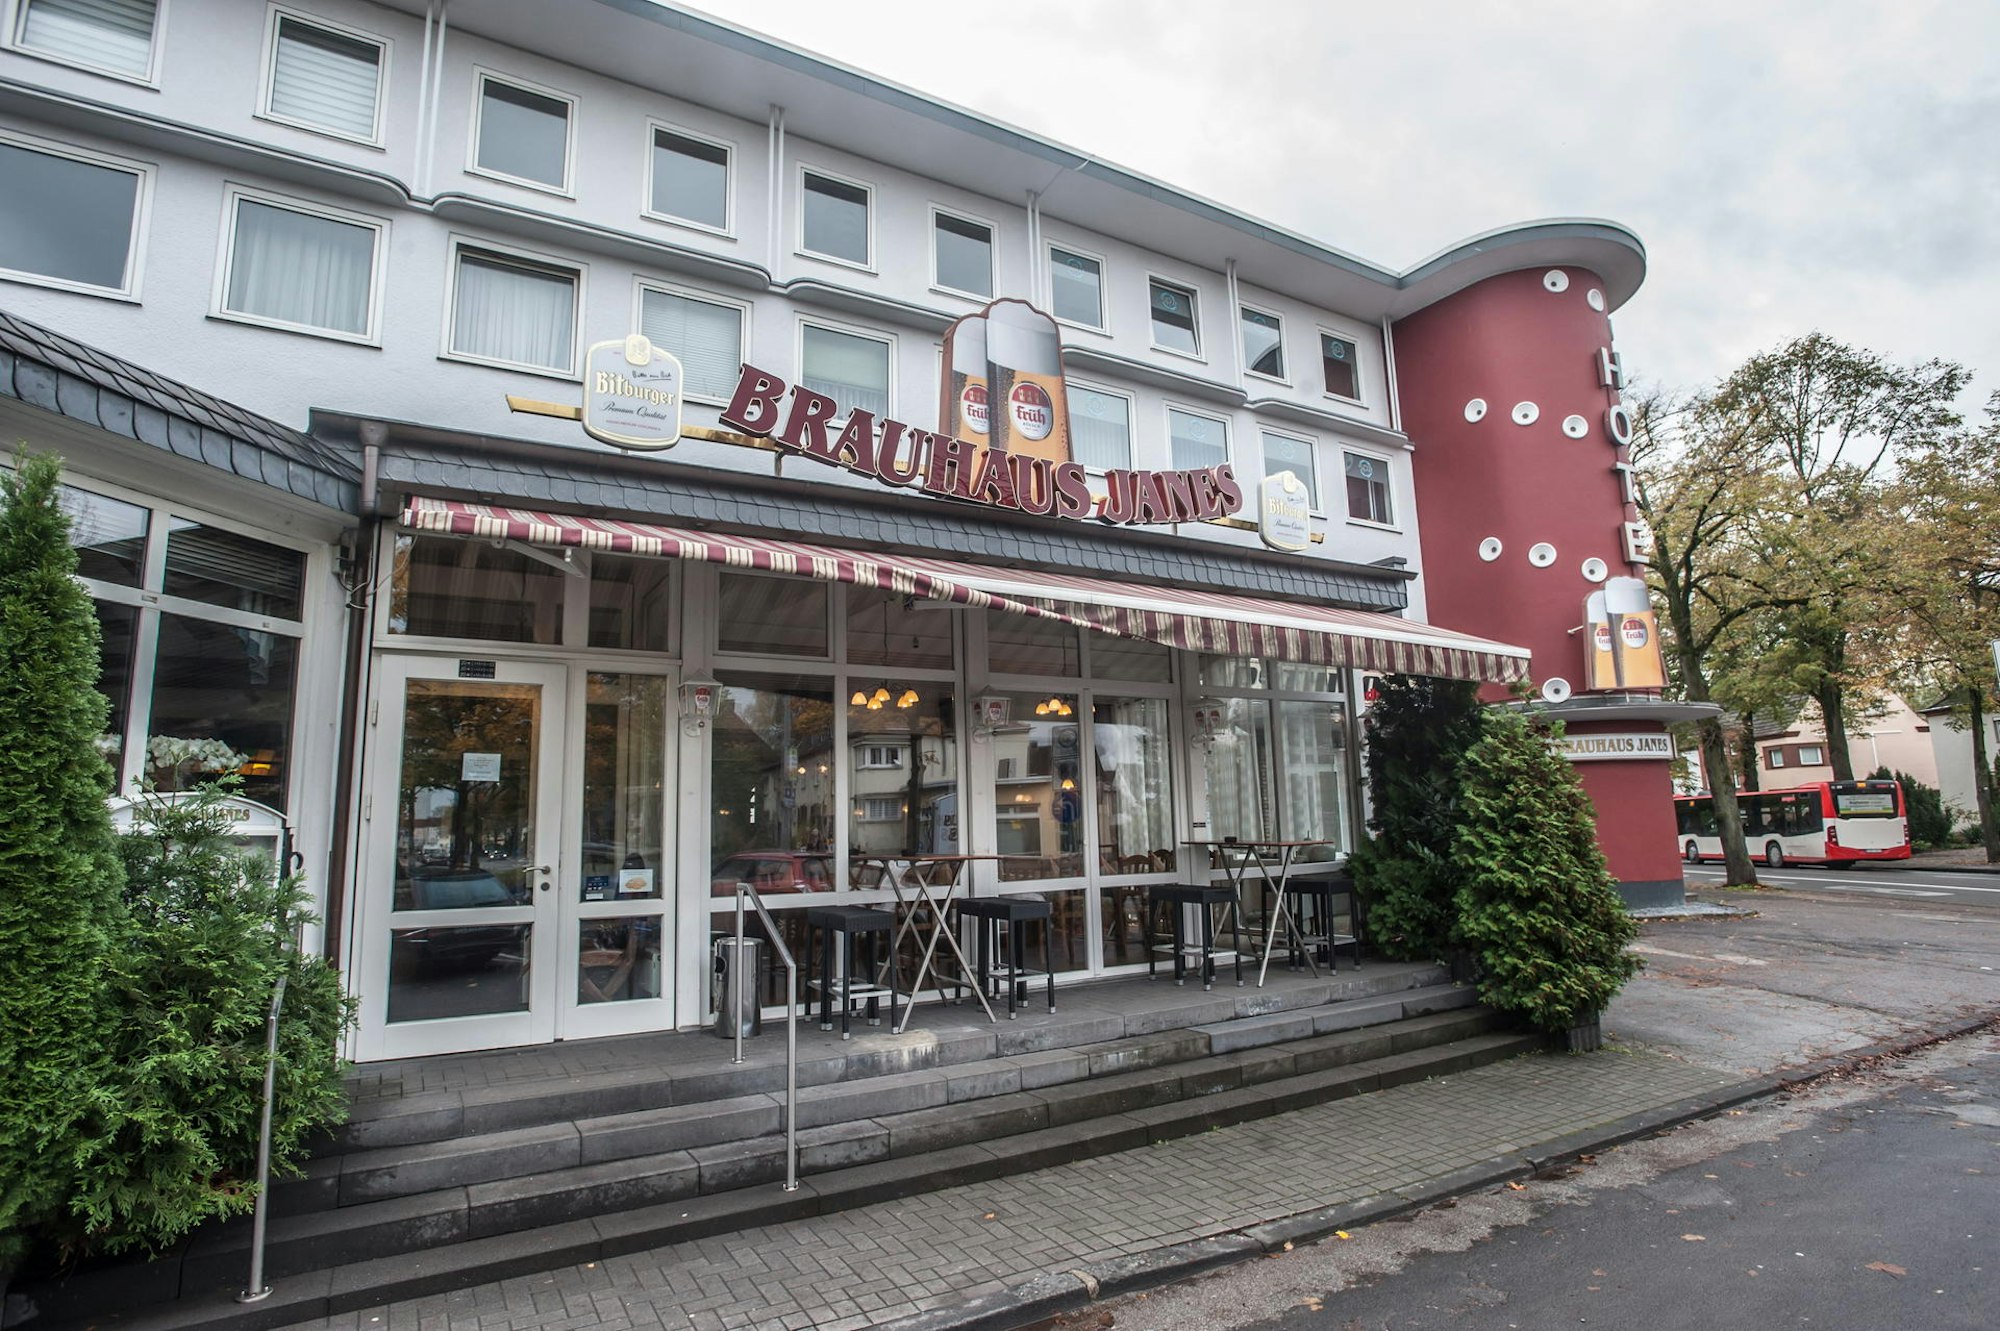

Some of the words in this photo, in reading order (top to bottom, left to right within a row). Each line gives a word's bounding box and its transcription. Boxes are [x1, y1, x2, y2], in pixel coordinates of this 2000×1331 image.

[596, 371, 676, 406] Bitburger
[1015, 405, 1047, 426] früh
[719, 363, 1093, 522] BRAUHAUS
[1098, 463, 1243, 525] JANES
[1556, 738, 1634, 754] RAUHAUS
[1636, 738, 1668, 752] JANES
